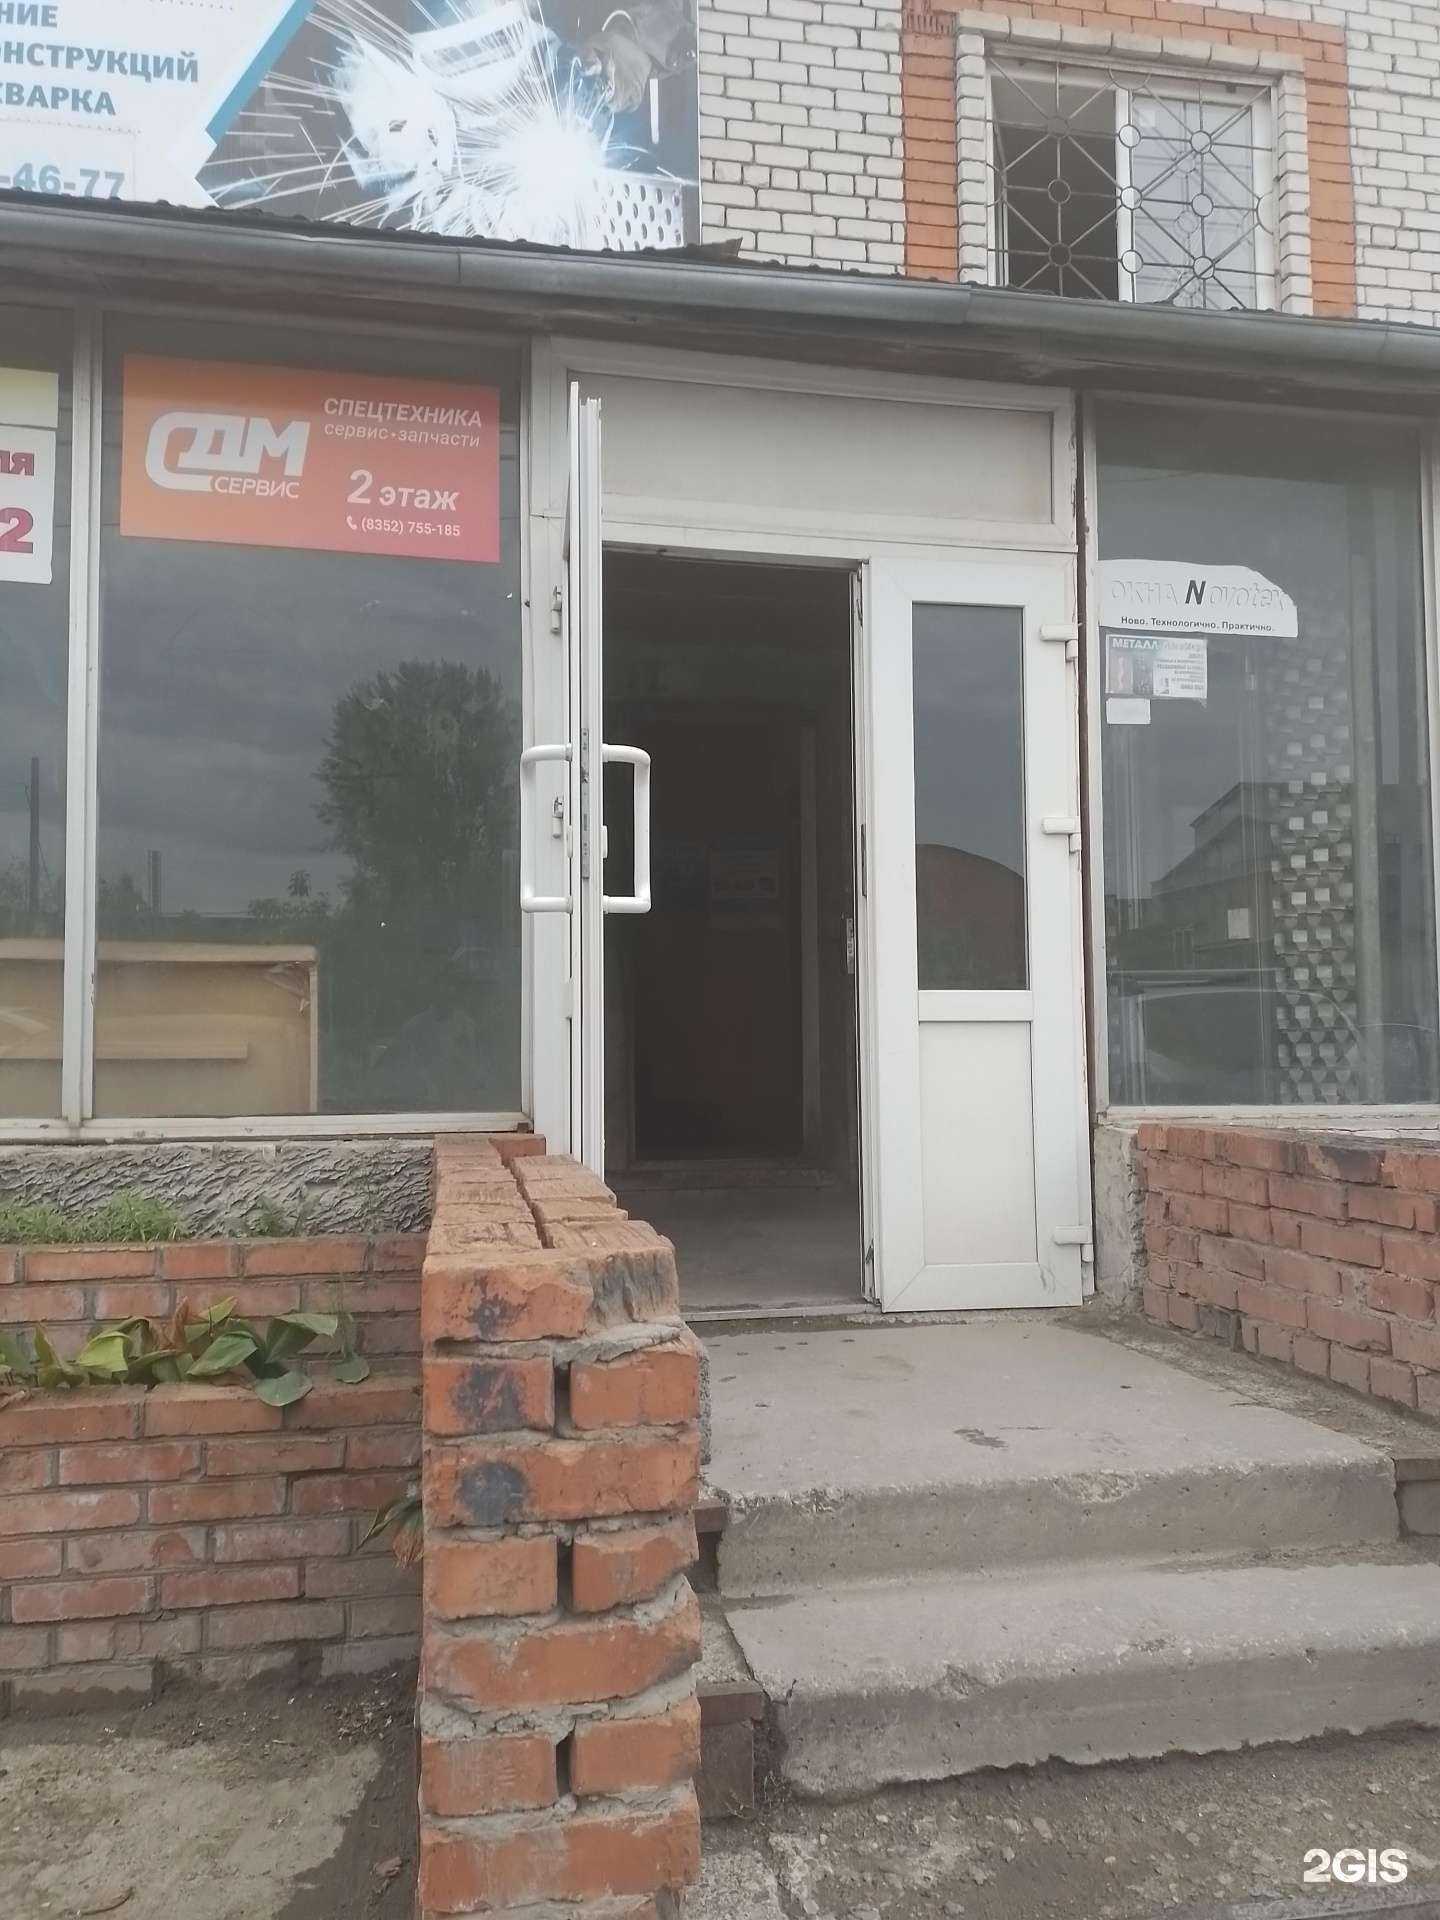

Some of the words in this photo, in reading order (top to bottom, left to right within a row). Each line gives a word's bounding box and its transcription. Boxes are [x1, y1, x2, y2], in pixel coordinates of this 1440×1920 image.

[0, 40, 199, 83] НСТРУКЦИЙ
[0, 82, 116, 116] ВАРКА
[324, 398, 483, 427] СПЕЦТЕХНИКА
[145, 411, 310, 492] СДМ
[212, 475, 300, 498] СЕРВИС
[347, 469, 373, 504] 2
[379, 486, 461, 511] этаж
[361, 517, 404, 535] (8352)
[408, 521, 461, 537] 755-185
[1121, 616, 1148, 626] Ново.
[1151, 617, 1221, 631] Технологично.
[1222, 620, 1275, 633] Практично.
